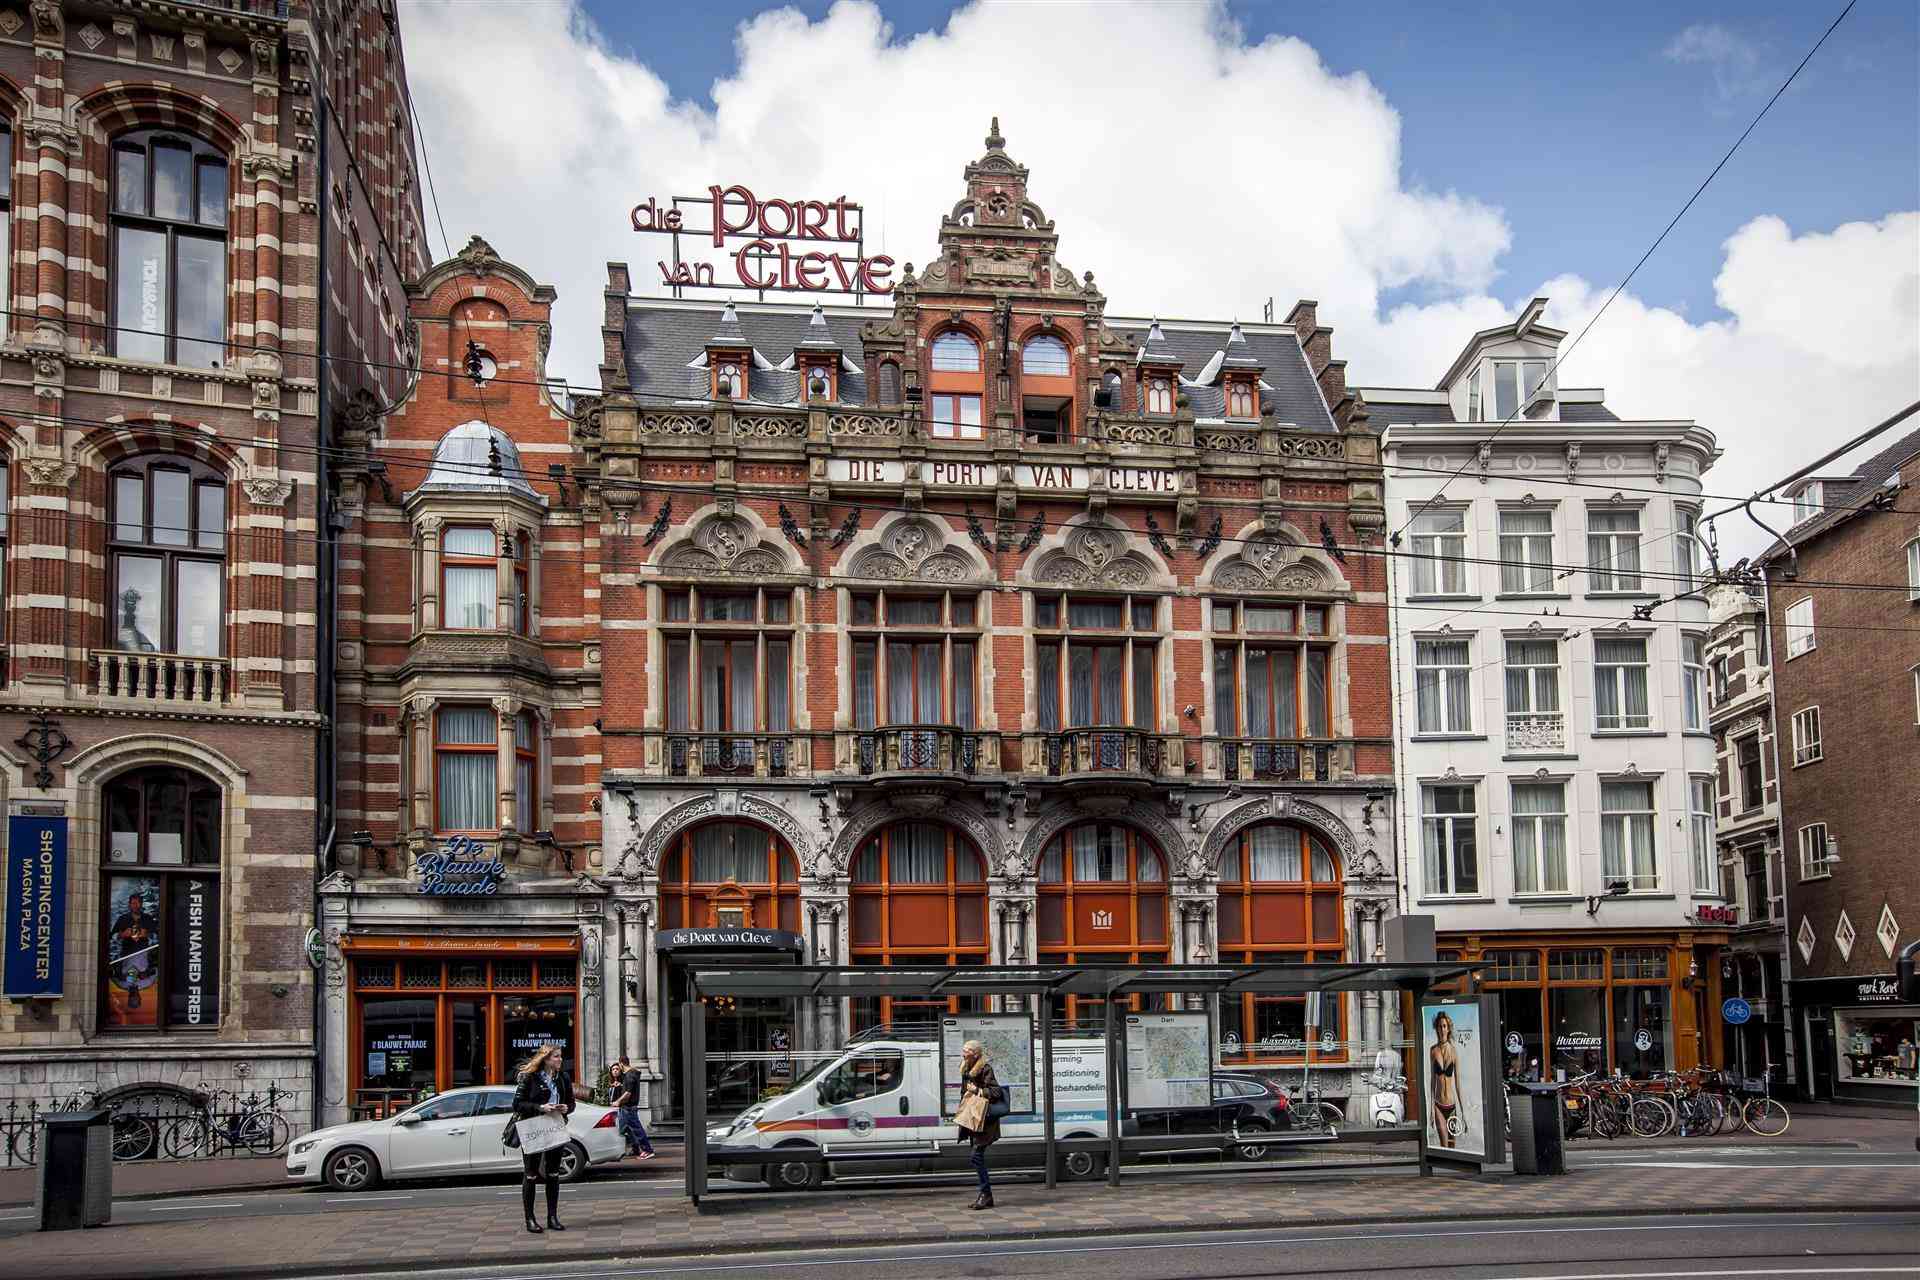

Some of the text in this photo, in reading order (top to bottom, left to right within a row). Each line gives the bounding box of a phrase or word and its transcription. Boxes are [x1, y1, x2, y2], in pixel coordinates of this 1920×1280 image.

[630, 197, 683, 231] die
[658, 239, 896, 294] van Cleve
[848, 460, 1176, 491] DIE PORT VAN CLEVE
[443, 833, 485, 856] De
[415, 851, 505, 874] Blauwe
[417, 872, 498, 895] Parade
[20, 858, 33, 951] MAGNA PLAZA
[36, 829, 54, 980] SHOPPINGCENTER
[673, 932, 689, 944] die
[719, 932, 739, 943] van
[740, 931, 772, 944] Cleve
[187, 880, 202, 1024] A FISH NAMED FRED
[377, 1040, 403, 1049] BLAUWE
[403, 1040, 427, 1049] PARADE
[517, 1039, 543, 1048] BLAUWE
